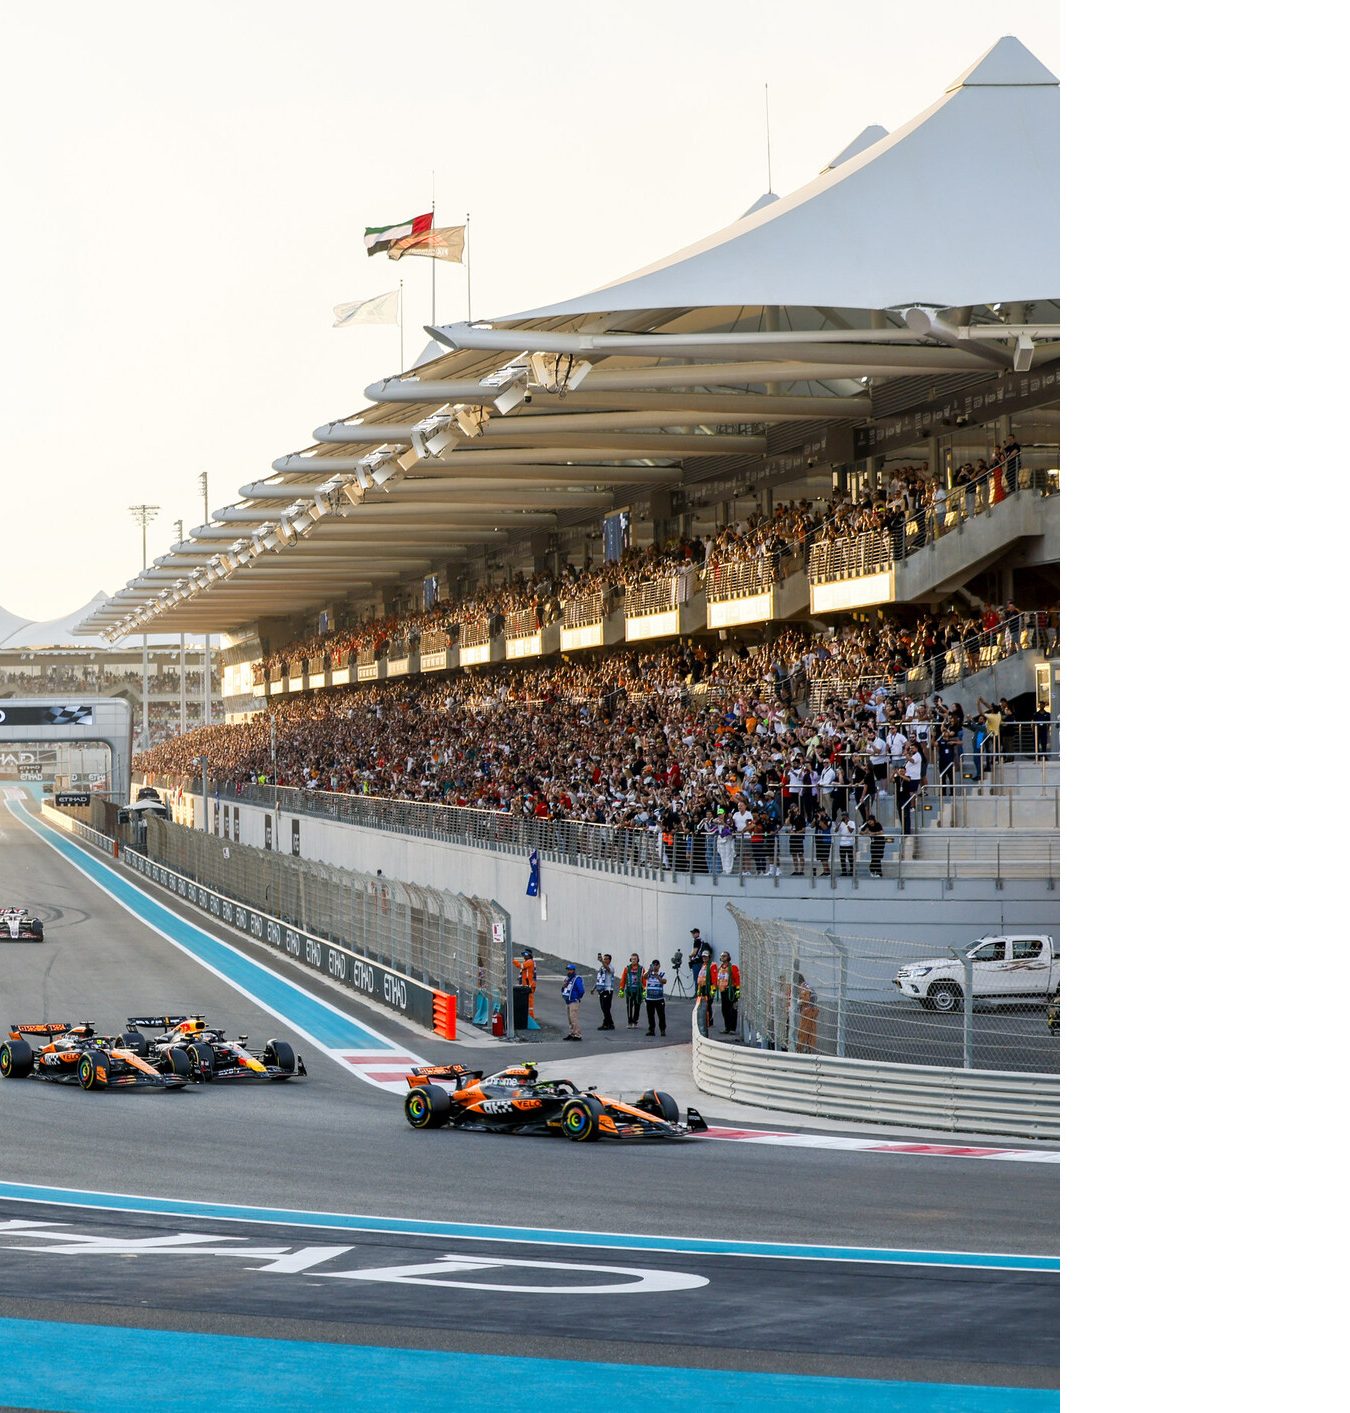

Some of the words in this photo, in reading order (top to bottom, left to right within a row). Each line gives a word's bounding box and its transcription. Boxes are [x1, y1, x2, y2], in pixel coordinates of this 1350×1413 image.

[267, 921, 280, 945] ETIHAD
[286, 930, 299, 956] ETIHAD
[306, 939, 321, 967] ETIHAD
[329, 949, 345, 979] ETIHAD
[354, 961, 373, 993] ETIHAD
[384, 973, 407, 1009] ETIHAD
[518, 1100, 542, 1108] VELO
